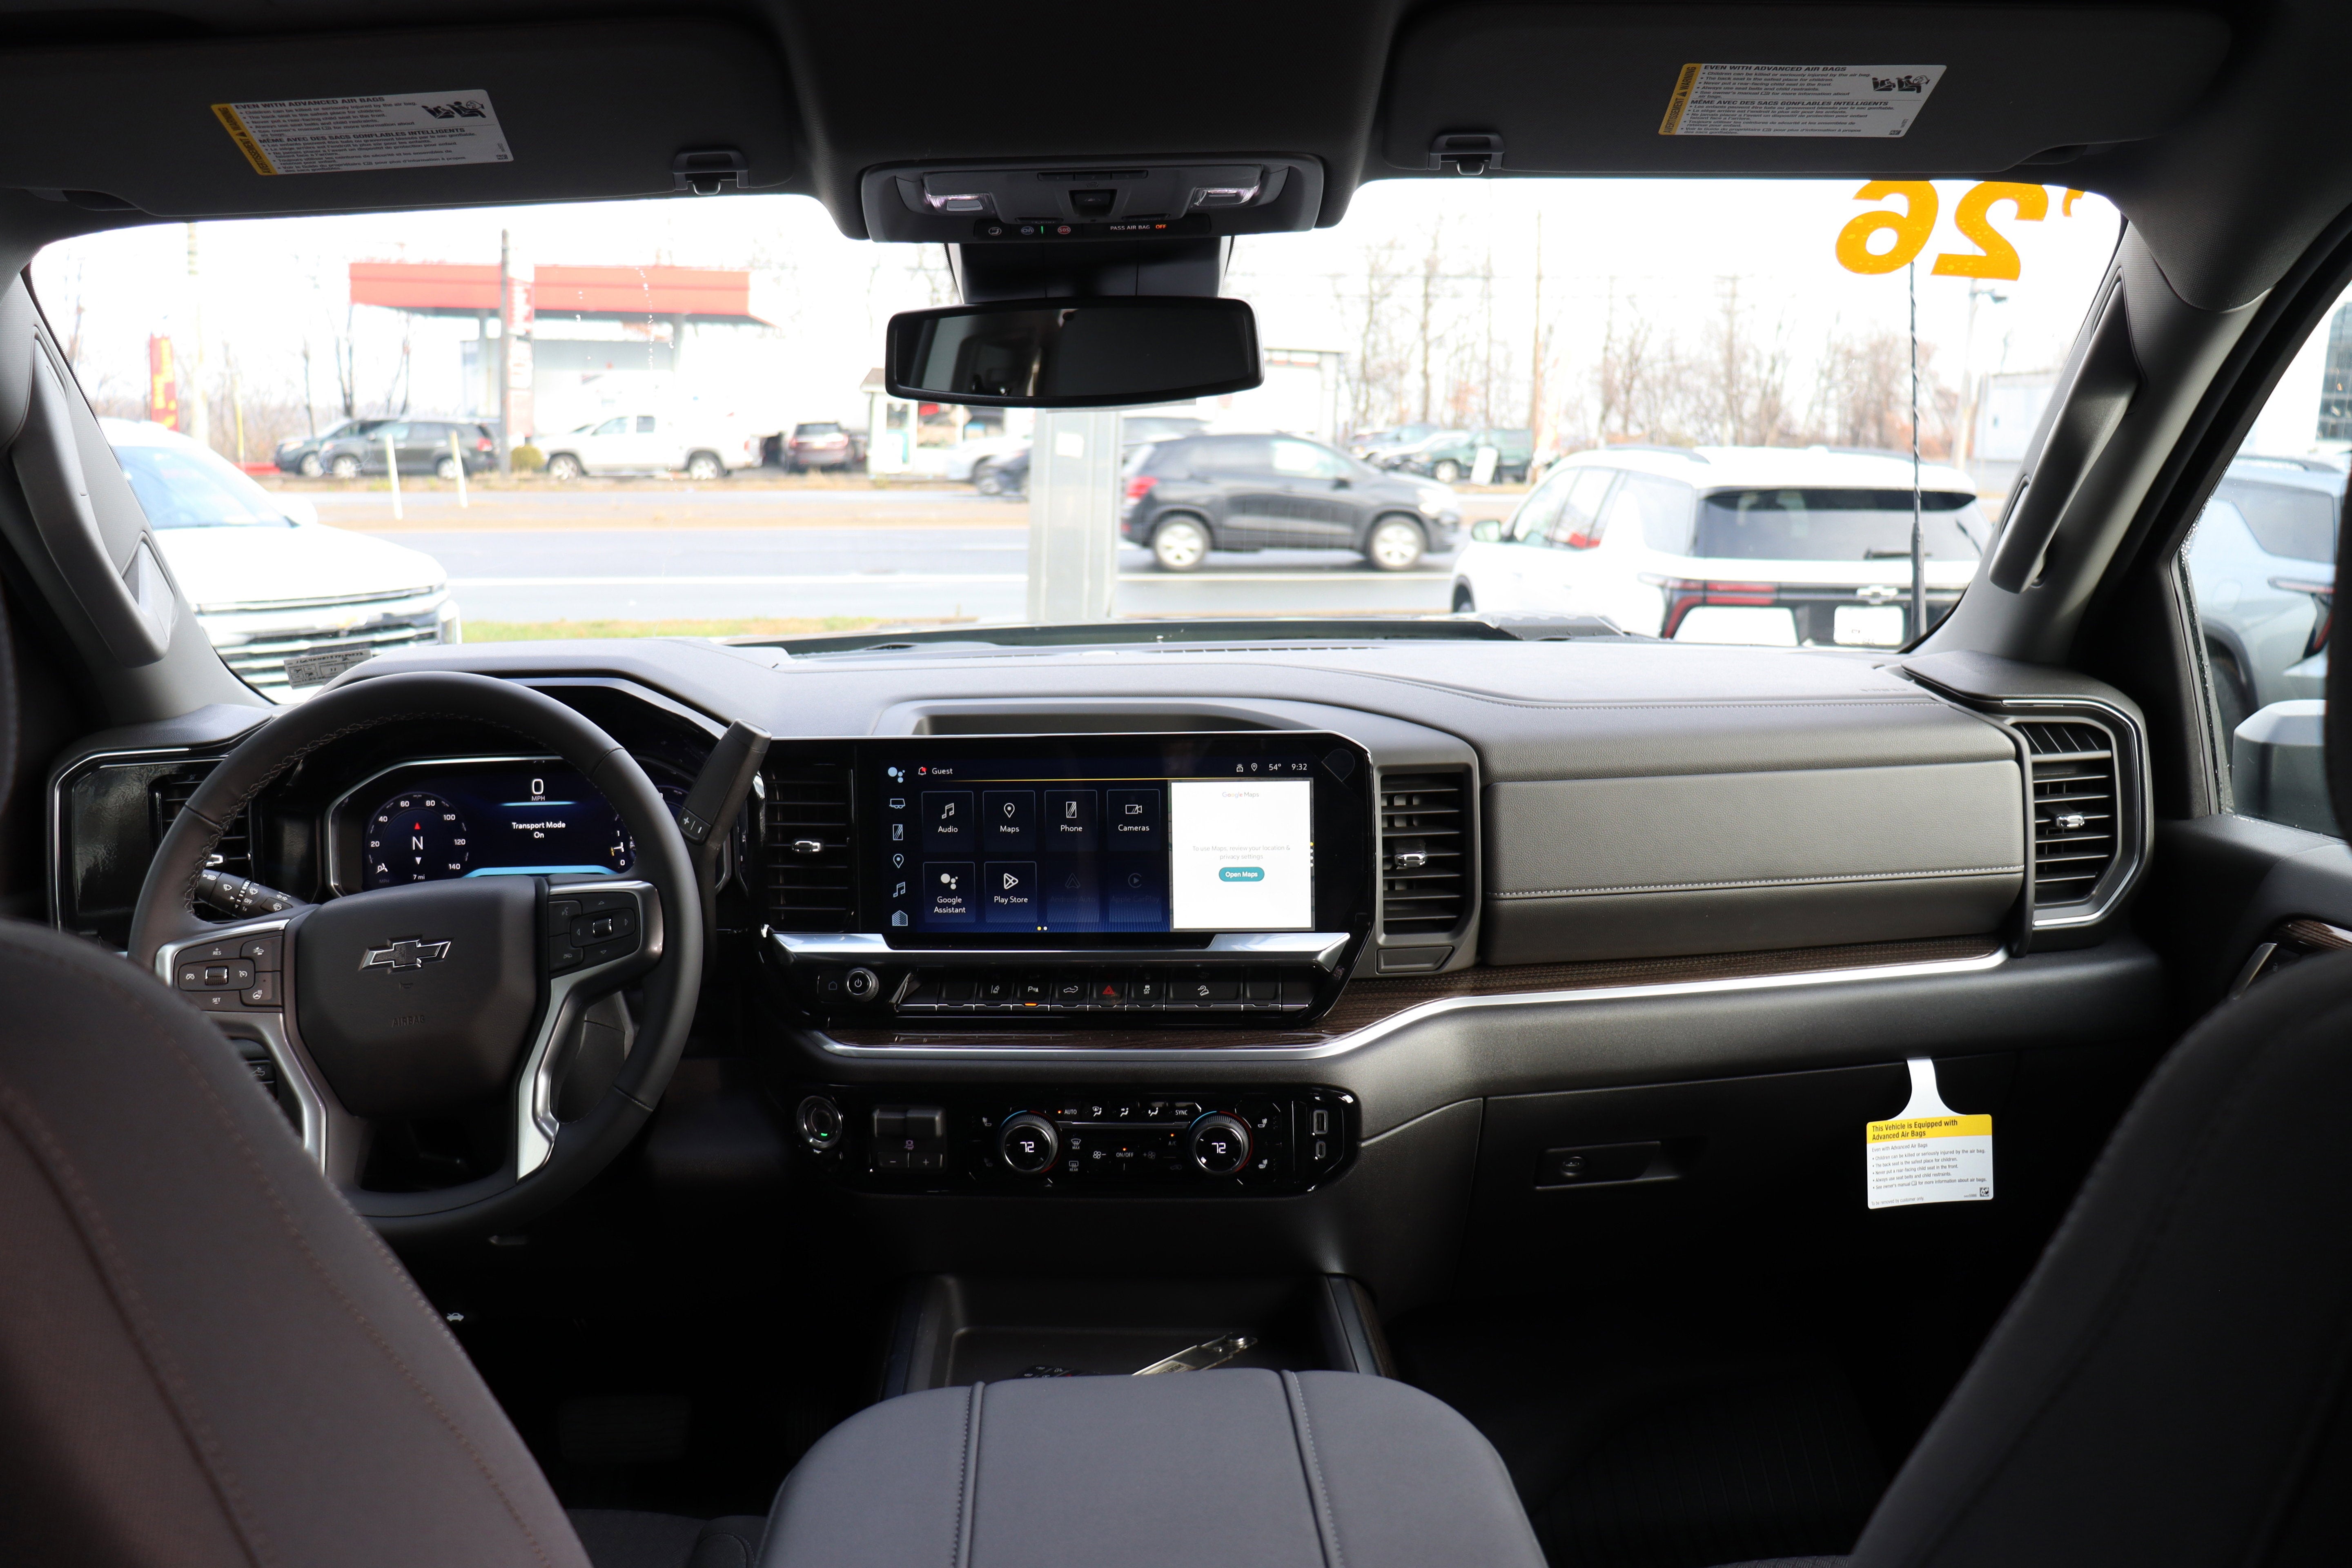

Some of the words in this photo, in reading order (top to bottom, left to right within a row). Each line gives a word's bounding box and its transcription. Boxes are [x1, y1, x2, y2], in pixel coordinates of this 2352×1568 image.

[1680, 67, 1696, 90] WARNING
[1664, 98, 1684, 133] AVERTISSEMENT
[532, 778, 544, 795] 0
[1222, 791, 1243, 799] Google
[512, 822, 545, 831] Transport
[1000, 825, 1020, 834] Maps
[412, 836, 423, 850] N
[937, 896, 962, 905] Google
[994, 895, 1009, 905] Play
[391, 1015, 425, 1027] AIRBAG
[1872, 1132, 1900, 1141] Advanced
[1020, 1141, 1034, 1153] 72
[1212, 1142, 1226, 1154] 72
